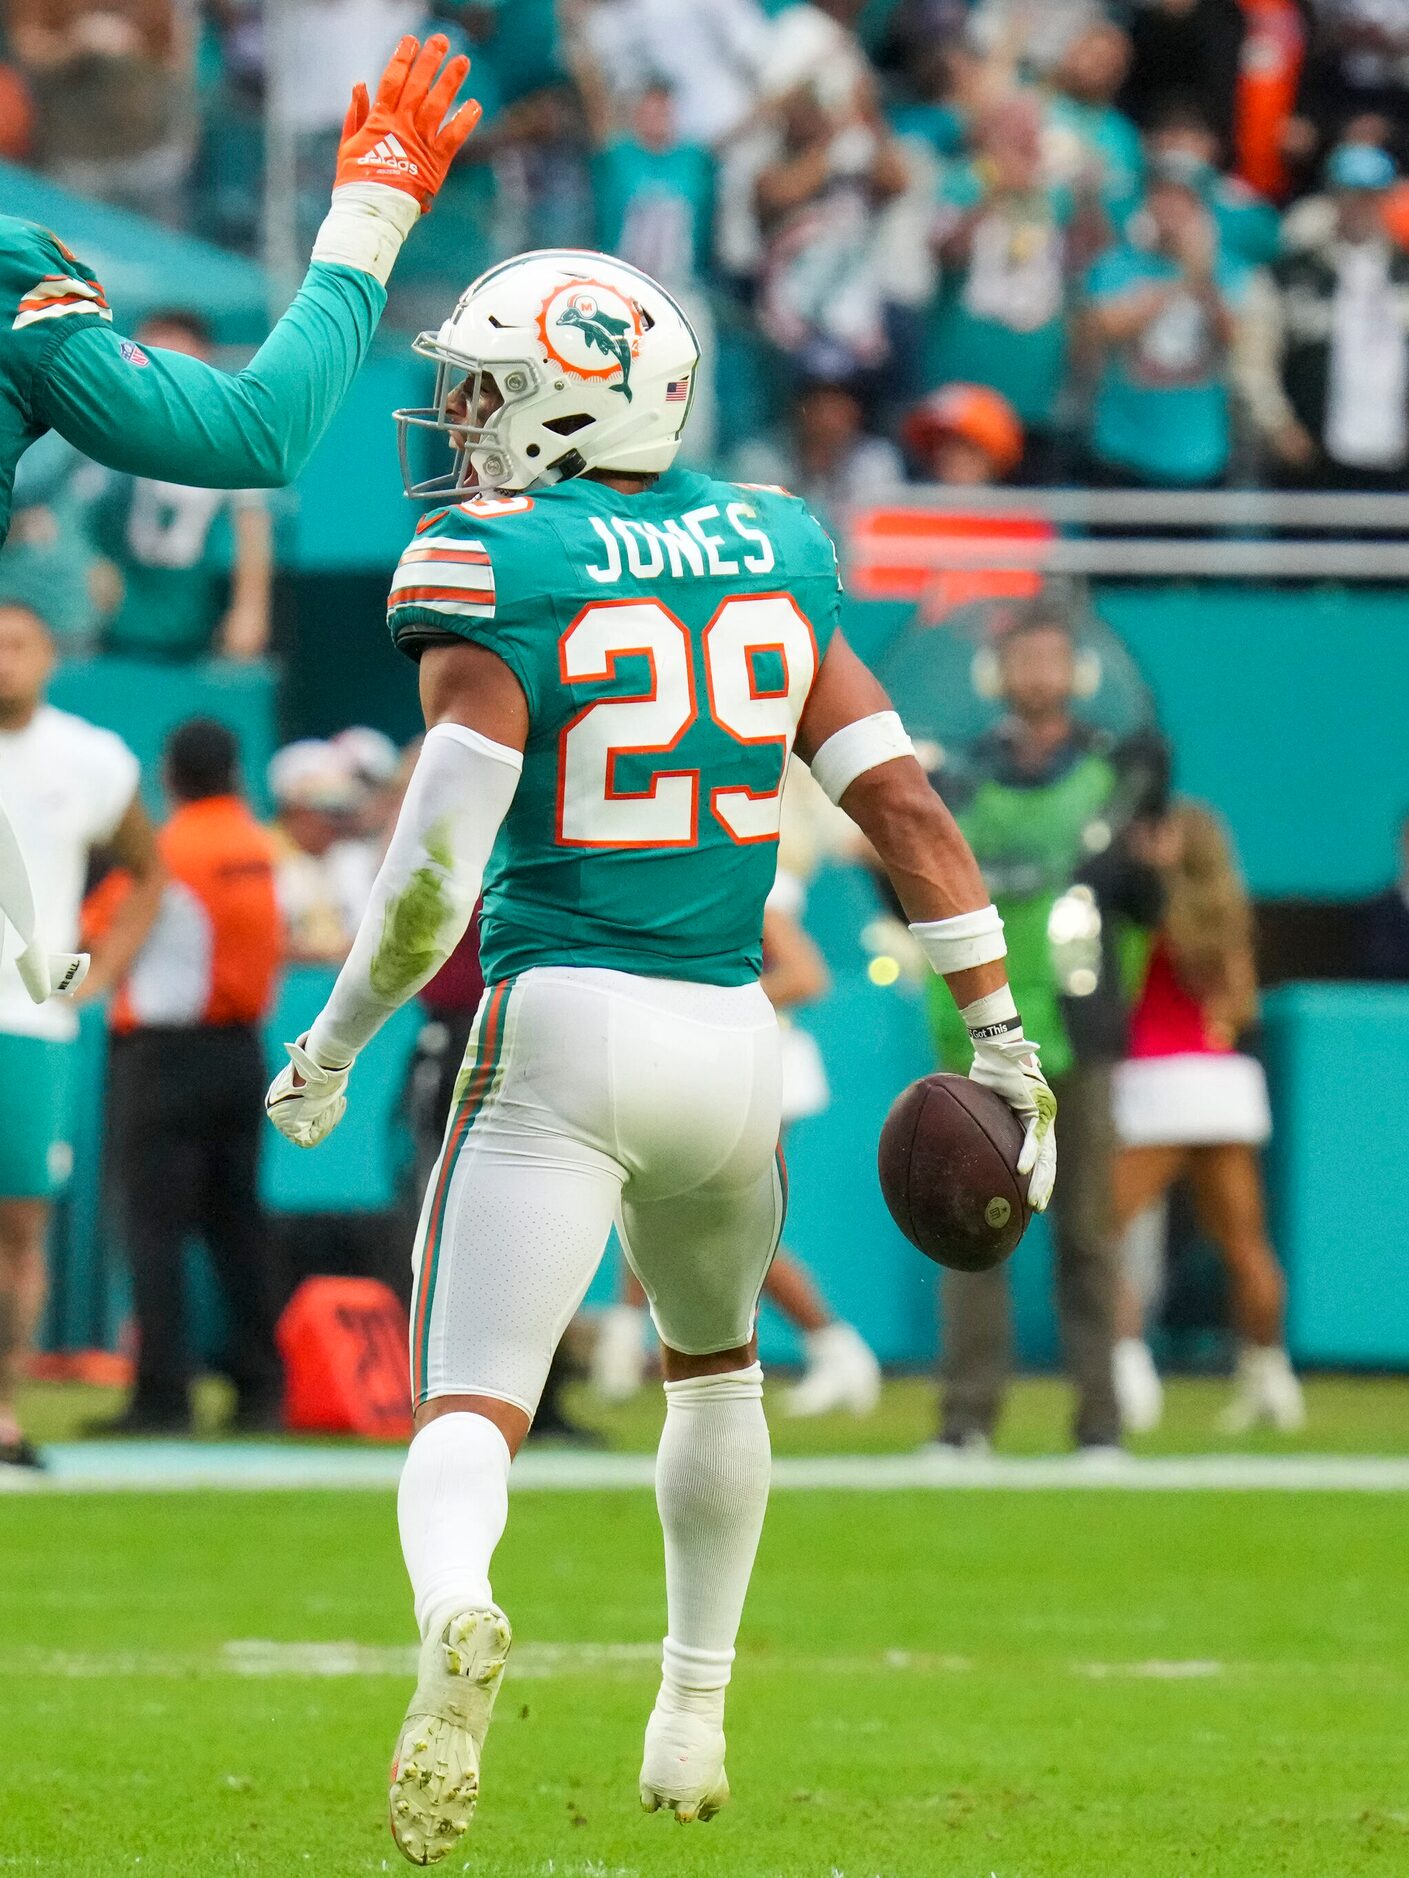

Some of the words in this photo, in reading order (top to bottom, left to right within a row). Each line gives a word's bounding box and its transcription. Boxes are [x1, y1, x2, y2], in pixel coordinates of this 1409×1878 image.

[357, 156, 419, 176] adidas
[585, 502, 775, 583] JONES
[555, 591, 820, 849] 29
[972, 1029, 987, 1039] Got
[987, 1023, 1008, 1037] This
